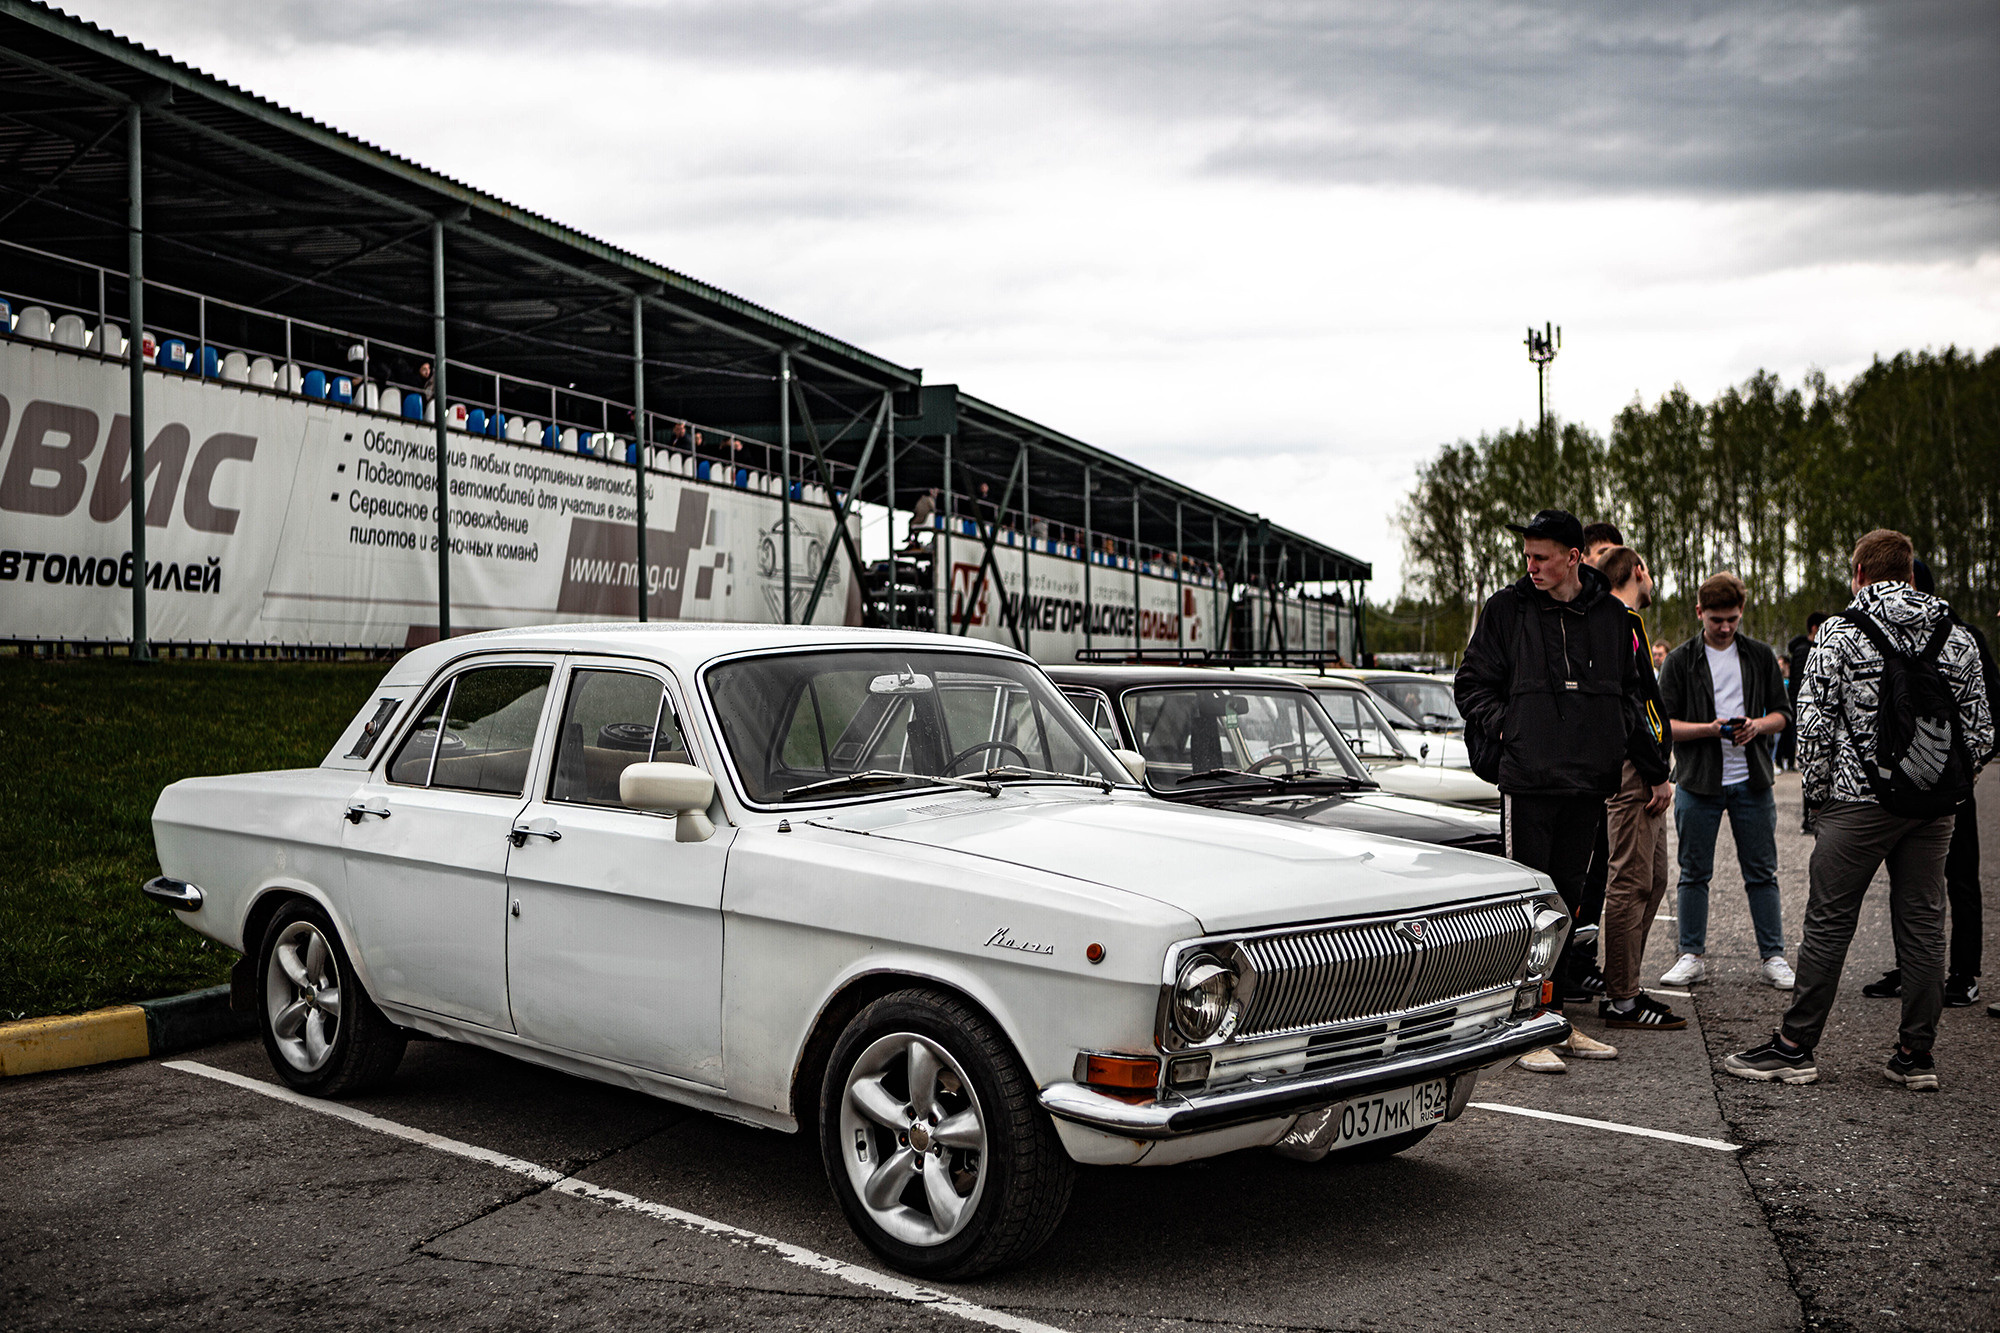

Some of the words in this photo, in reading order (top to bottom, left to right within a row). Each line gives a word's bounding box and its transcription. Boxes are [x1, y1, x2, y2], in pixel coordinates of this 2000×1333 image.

[0, 393, 258, 536] ВИС
[364, 428, 467, 468] Обслуживие
[470, 452, 511, 476] любых
[513, 462, 584, 488] спортивных
[357, 457, 440, 493] Подготовк
[449, 478, 535, 508] автомобилей
[537, 488, 558, 511] для
[560, 496, 606, 517] участия
[608, 503, 615, 520] в
[349, 489, 429, 522] Сервисное
[432, 505, 529, 535] спровождение
[349, 525, 417, 551] пилотов
[419, 533, 428, 551] и
[431, 534, 494, 559] гночных
[497, 542, 539, 563] команд
[1415, 1081, 1443, 1112] 152
[1420, 1111, 1435, 1123] RUS
